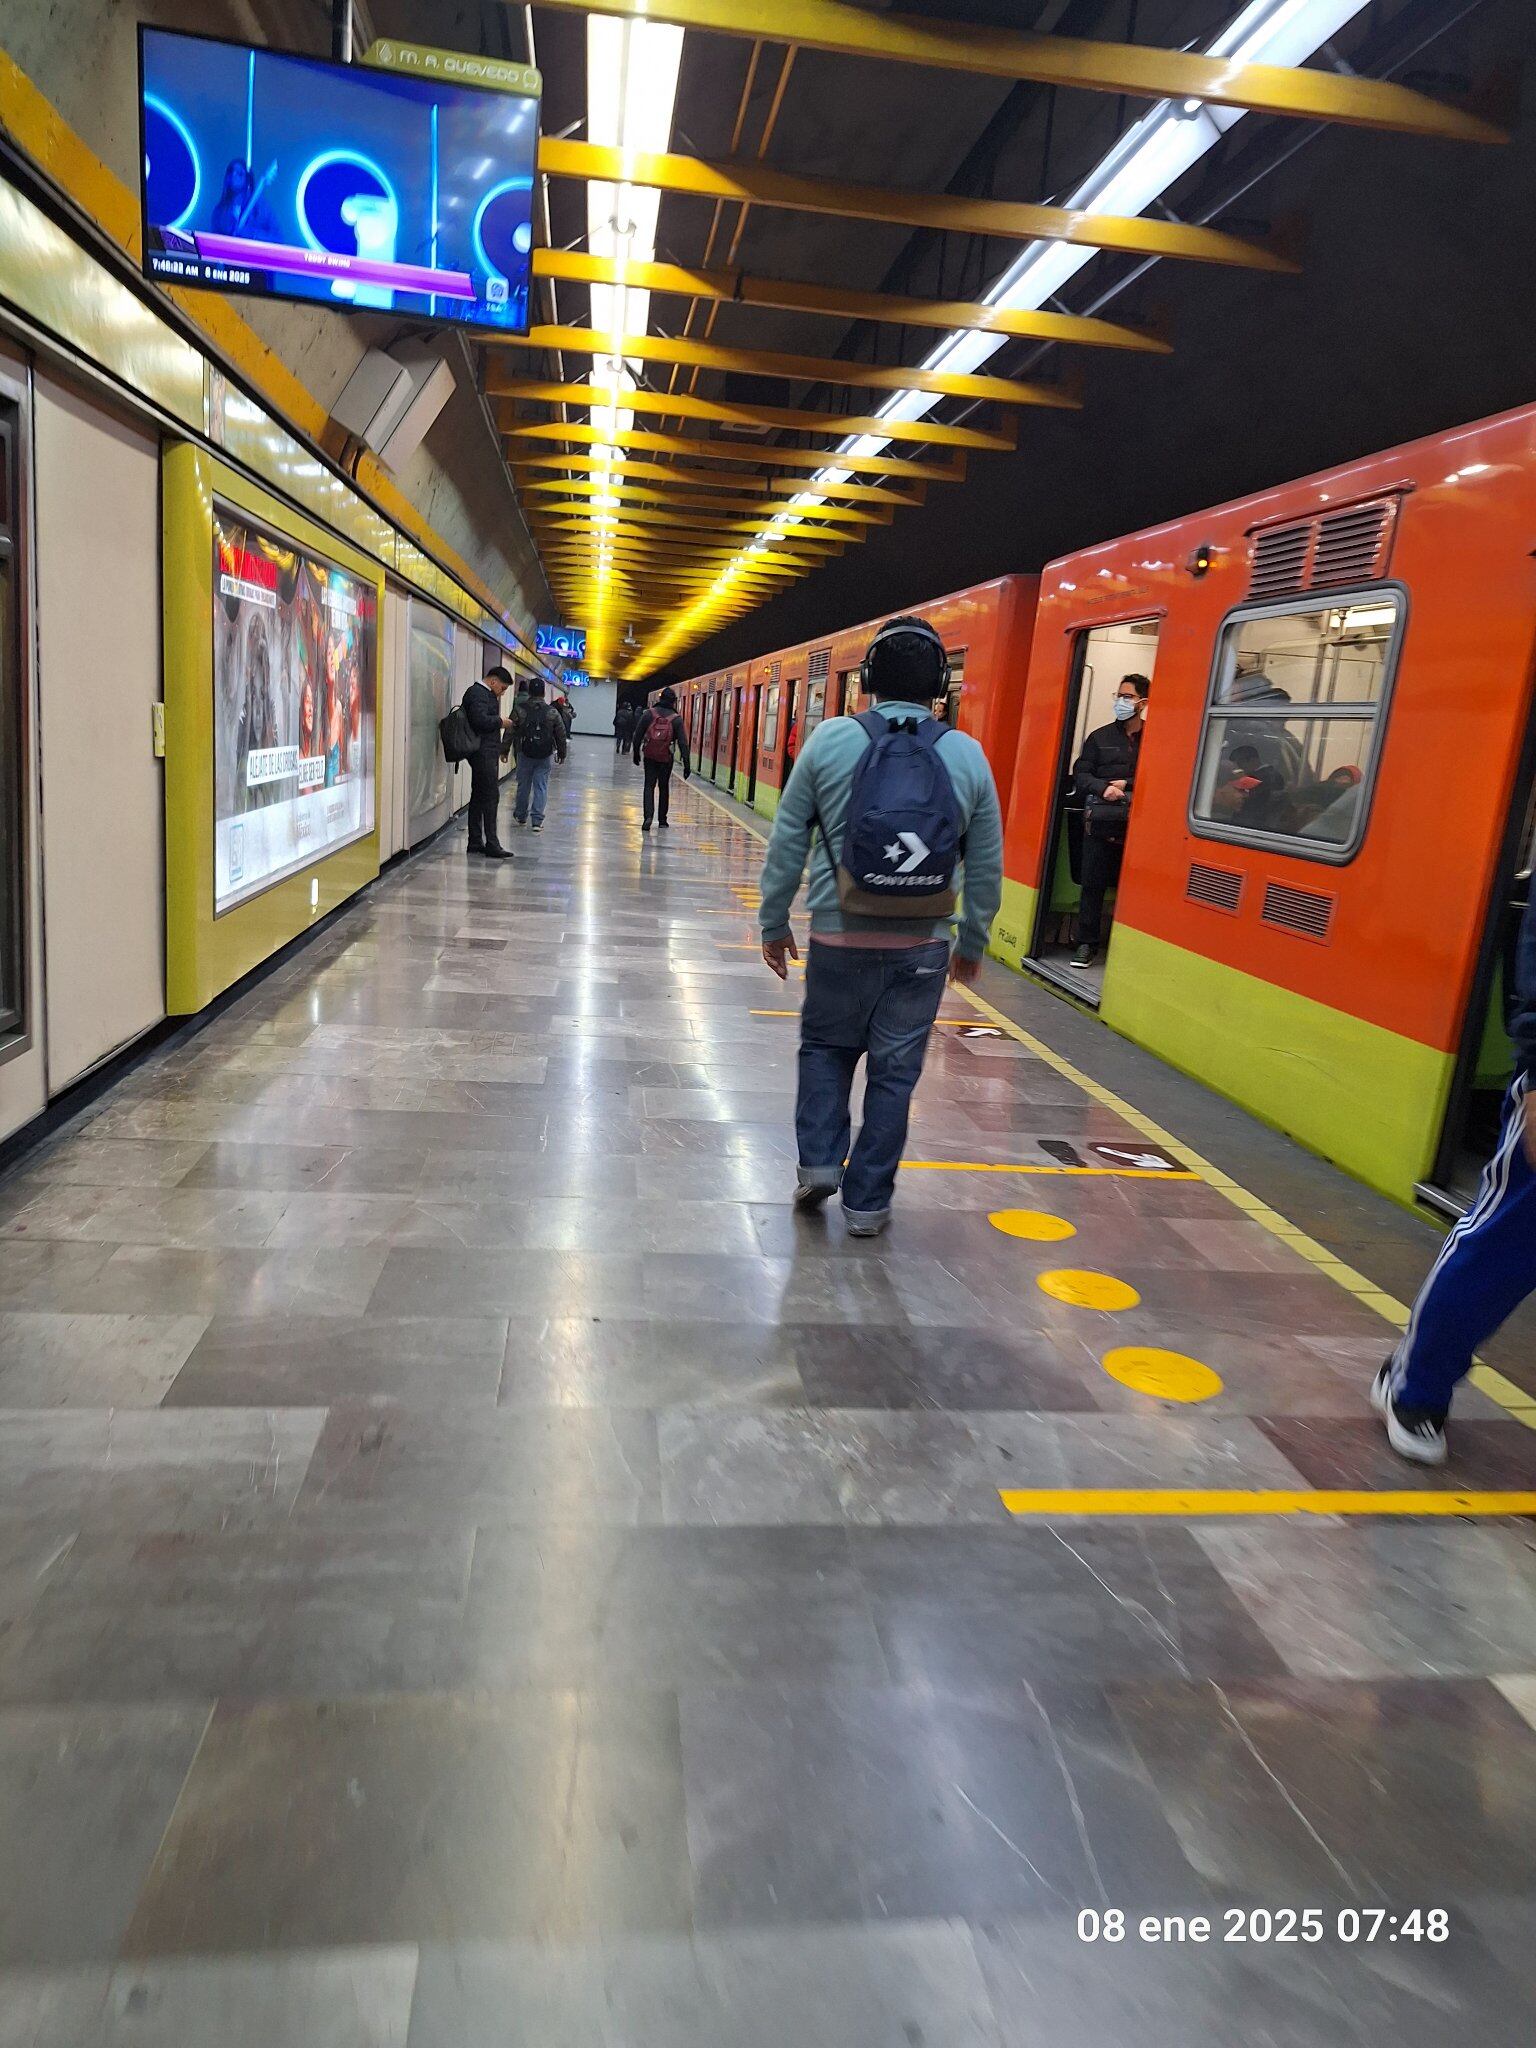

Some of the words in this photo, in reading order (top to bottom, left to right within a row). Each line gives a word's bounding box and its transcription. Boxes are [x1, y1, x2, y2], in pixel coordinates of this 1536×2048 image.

[445, 57, 520, 82] QUEVEDO
[185, 265, 199, 277] AM
[863, 872, 945, 886] CONVERSE
